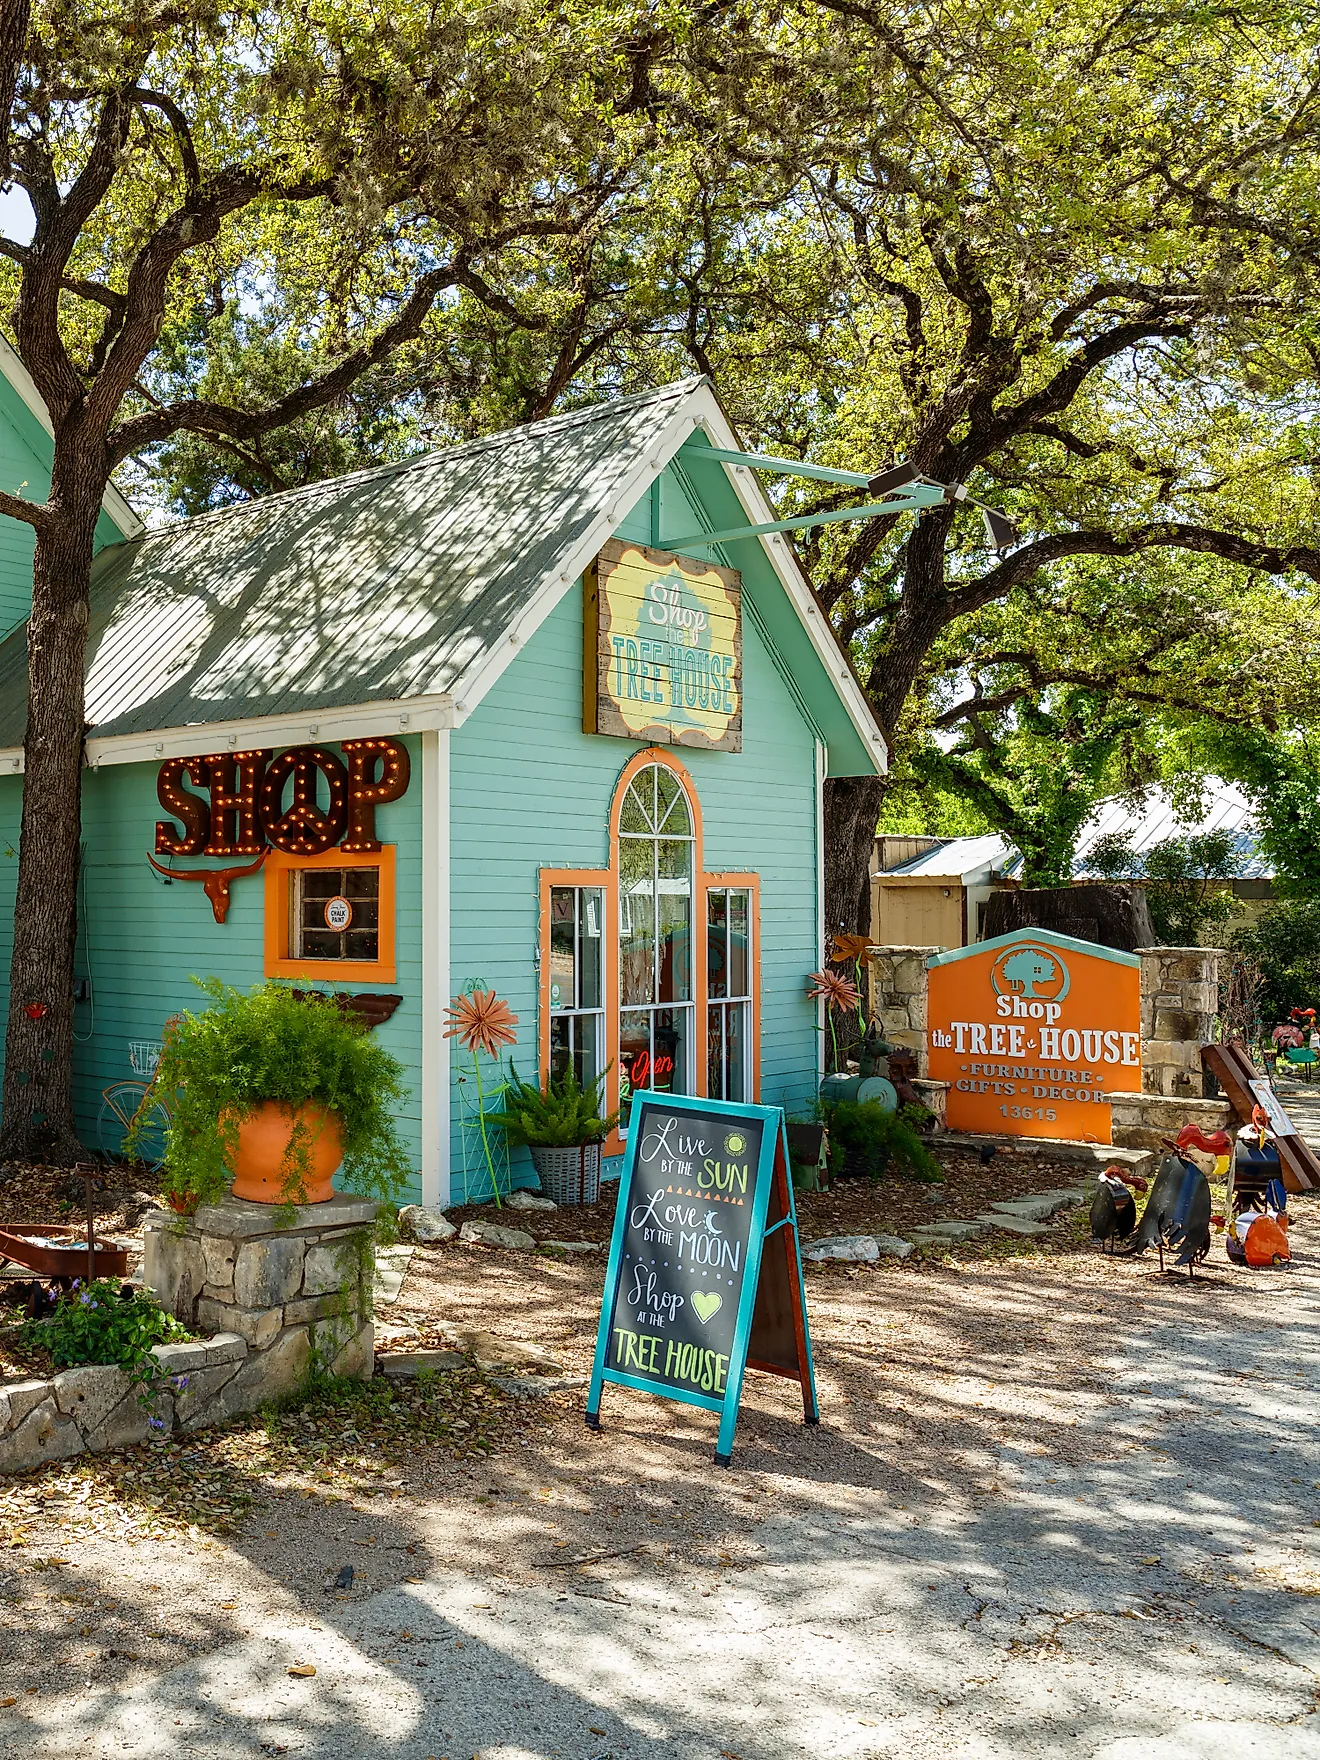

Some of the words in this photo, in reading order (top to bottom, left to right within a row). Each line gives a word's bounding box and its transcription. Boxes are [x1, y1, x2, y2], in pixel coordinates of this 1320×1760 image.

[649, 583, 707, 647] Shop
[613, 636, 664, 702] TREE
[669, 645, 733, 713] HOUSE
[154, 737, 411, 856] SHOP
[996, 995, 1062, 1026] Shop
[932, 1029, 952, 1048] the
[950, 1022, 1026, 1058] TREE
[1039, 1027, 1140, 1066] HOUSE
[631, 1051, 674, 1088] Open
[956, 1079, 1016, 1096] GIFTS
[1032, 1085, 1107, 1103] DECOR
[969, 1063, 1093, 1084] FURNITURE
[999, 1104, 1057, 1121] 13615
[640, 1117, 713, 1163] Live
[661, 1160, 675, 1173] BY
[676, 1160, 694, 1177] THE
[697, 1158, 748, 1194] SUN
[631, 1188, 702, 1233] Love
[643, 1227, 656, 1241] BY
[657, 1229, 674, 1246] THE
[677, 1230, 741, 1272] MOON
[627, 1263, 685, 1322] Shop
[636, 1310, 648, 1324] AT
[649, 1313, 666, 1329] THE
[613, 1327, 663, 1375] TREE
[664, 1339, 730, 1394] HOUSE
